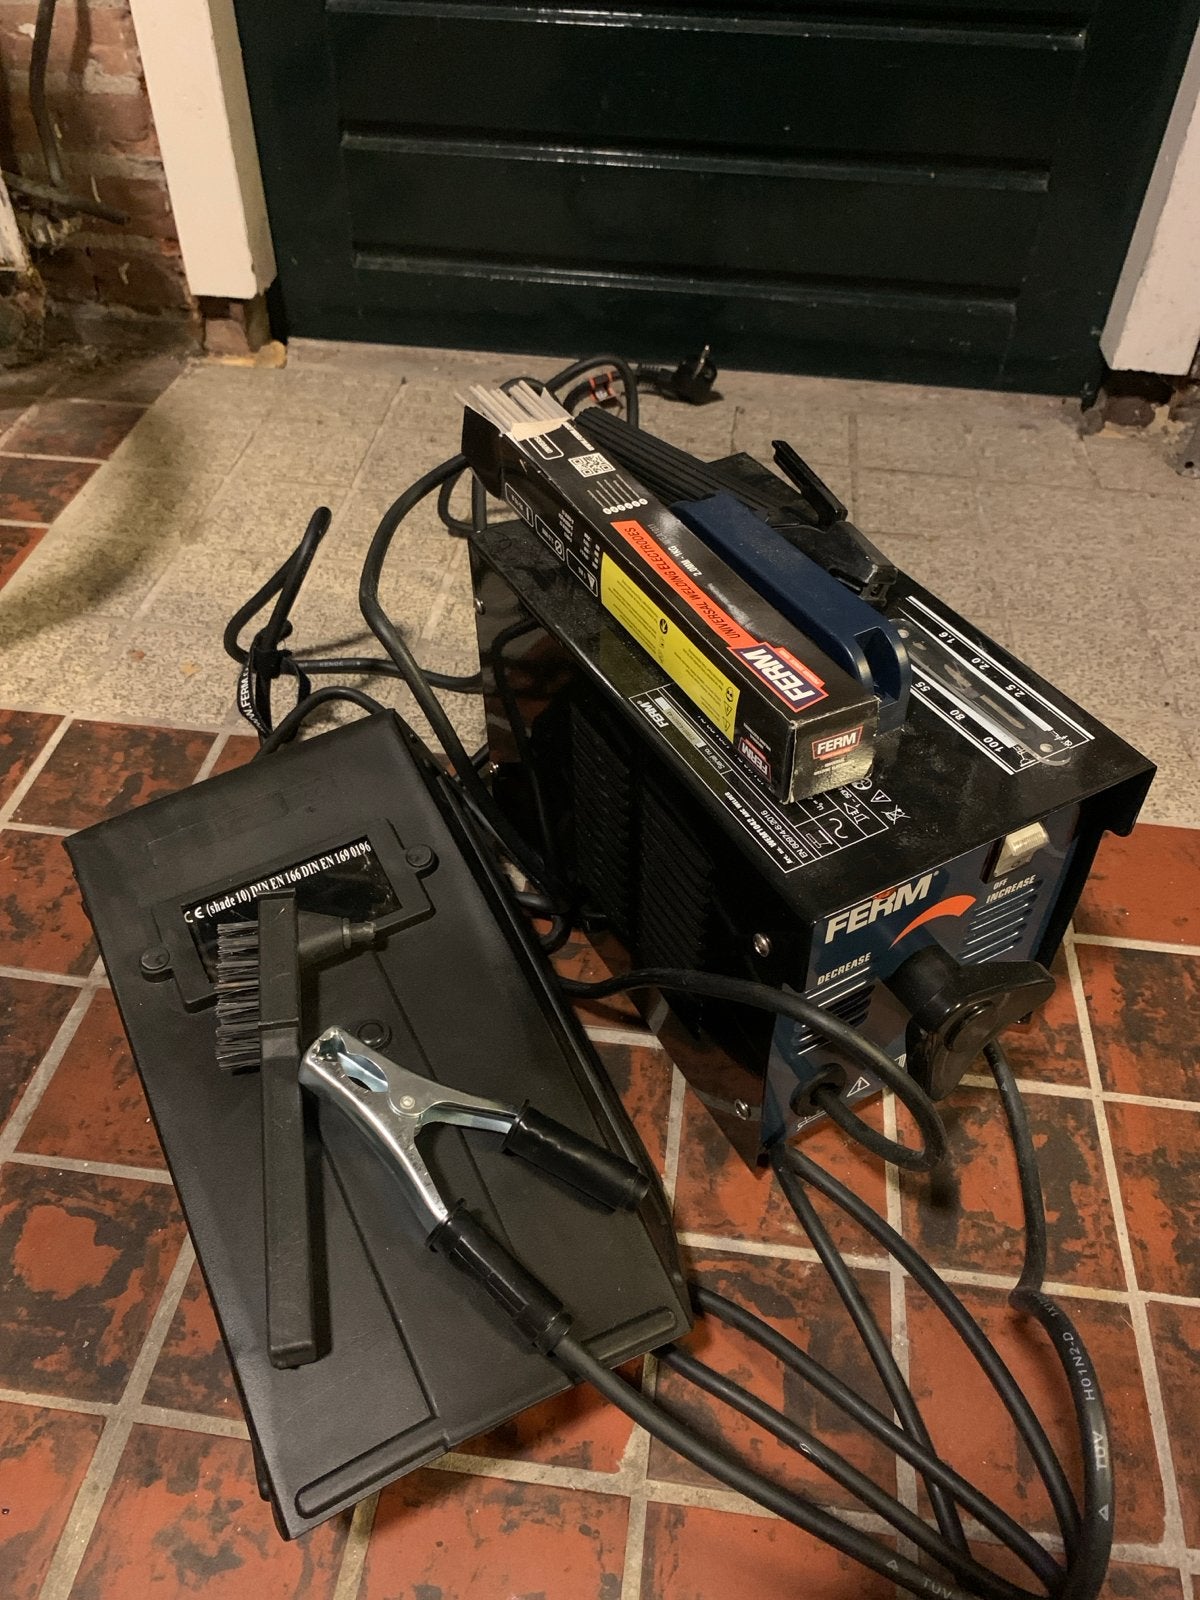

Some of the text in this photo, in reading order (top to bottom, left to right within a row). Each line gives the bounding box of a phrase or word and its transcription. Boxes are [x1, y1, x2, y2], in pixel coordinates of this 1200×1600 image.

[624, 527, 666, 570] ELECTRODES
[665, 569, 701, 600] WELDING
[696, 600, 741, 640] UNIVERSAL
[938, 632, 955, 645] 1.6
[743, 648, 816, 702] FERM
[971, 657, 990, 671] 2.0
[915, 681, 931, 692] 55
[1005, 684, 1027, 698] 2.5
[643, 701, 669, 728] FERM
[949, 709, 966, 721] 80
[741, 742, 769, 776] FERM
[817, 735, 857, 755] FERM
[982, 736, 1004, 753] 100
[798, 848, 809, 858] EN
[206, 896, 235, 917] (shade
[236, 889, 252, 905] 10)
[270, 875, 285, 890] EN
[285, 868, 301, 884] 166
[300, 861, 320, 877] DIN
[320, 854, 335, 870] EN
[335, 849, 350, 864] 169
[350, 841, 371, 857] 0196
[986, 874, 1037, 904] INCREASE
[824, 873, 936, 944] FERM
[817, 952, 871, 986] DECREASE
[1062, 1331, 1096, 1401] H01N2-D
